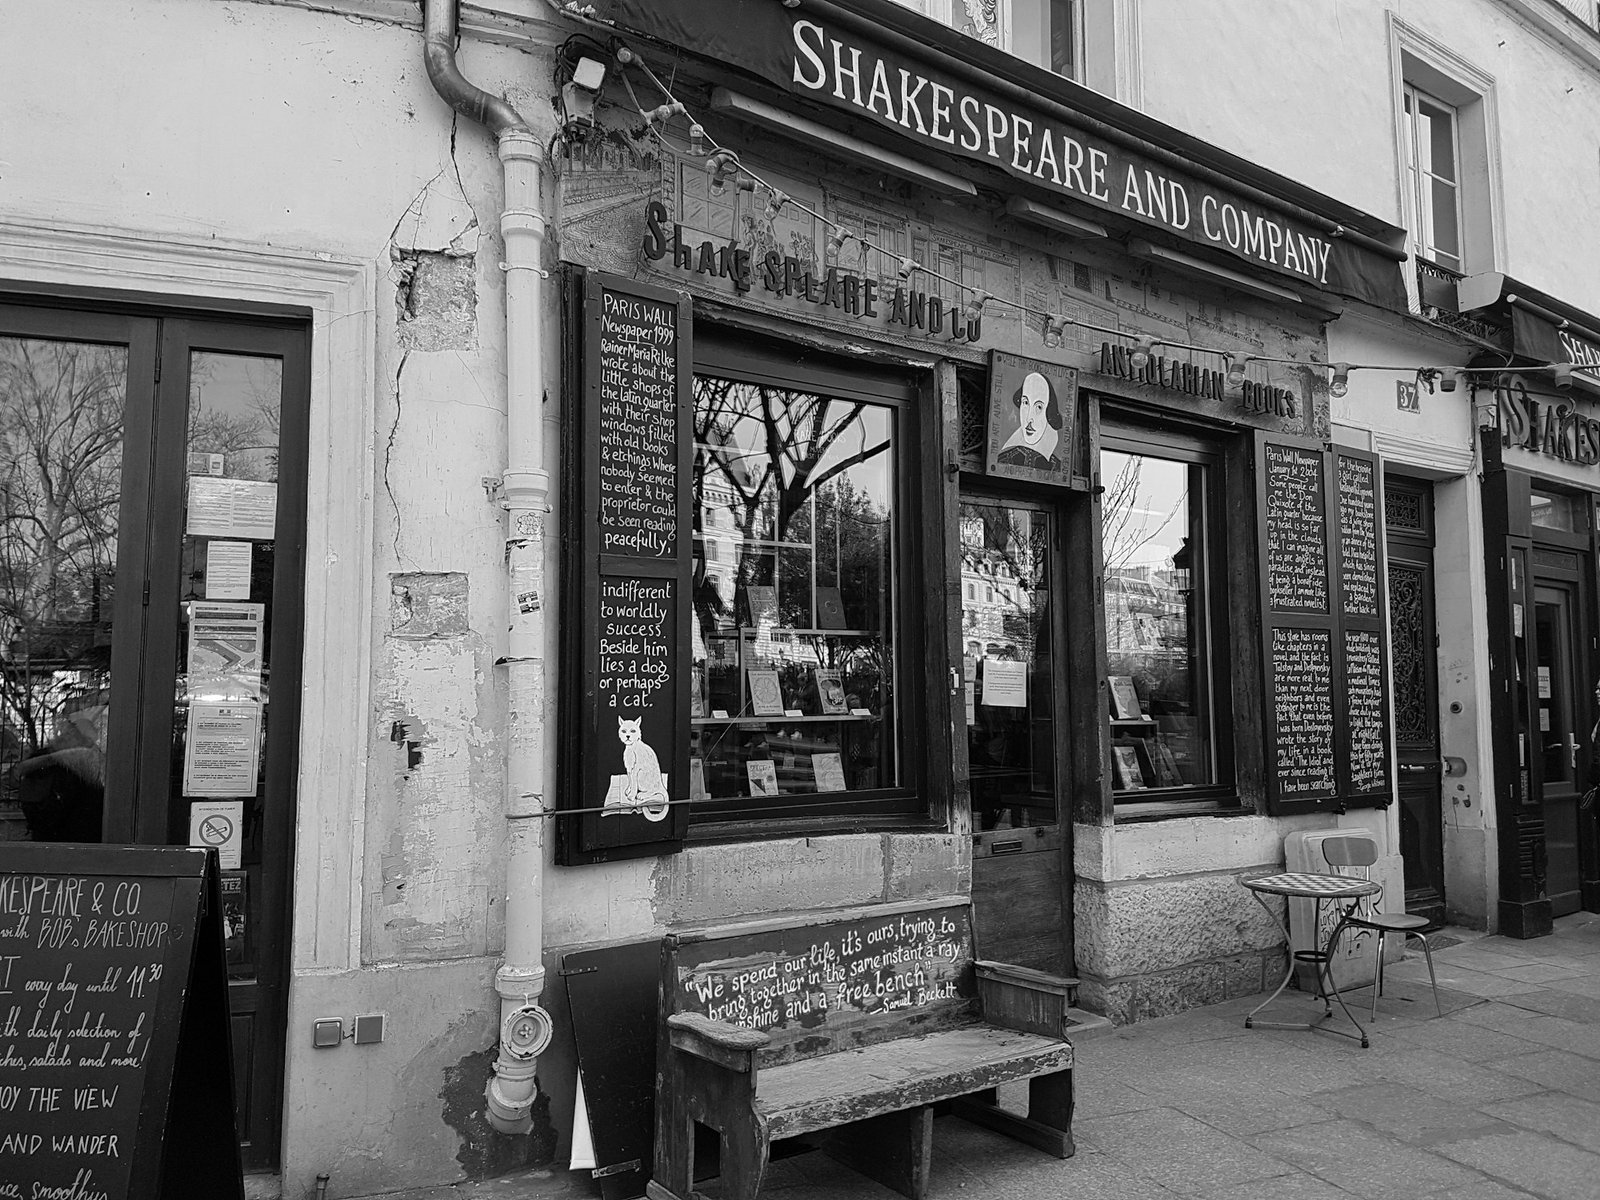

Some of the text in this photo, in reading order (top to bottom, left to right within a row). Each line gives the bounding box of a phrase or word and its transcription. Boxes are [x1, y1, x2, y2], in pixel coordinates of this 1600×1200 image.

[792, 19, 1332, 285] SHAKESPEARE AND COMPANY
[603, 293, 675, 328] PARIS WALL
[892, 287, 943, 334] AND
[602, 314, 674, 346] Newspaper 1999
[601, 338, 675, 368] Rainer Maria Rilke
[601, 356, 675, 384] wrote about the
[601, 385, 676, 413] the latin quarter
[602, 368, 675, 403] little shops of
[1242, 379, 1296, 419] BOOKS
[1399, 384, 1417, 409] 37
[601, 417, 675, 444] windows filled
[602, 401, 675, 433] with their shop
[601, 430, 669, 456] with old books
[1266, 446, 1282, 462] Paris
[601, 446, 676, 474] & etchings. Where
[601, 463, 675, 488] nobody seemed
[1268, 475, 1287, 488] Some
[601, 479, 674, 502] to enter & the
[1267, 494, 1295, 509] Quixote
[1304, 501, 1317, 512] the
[1285, 488, 1297, 499] the
[1299, 490, 1313, 502] Don
[602, 496, 676, 517] proprietor could
[1267, 506, 1283, 518] Latin
[602, 510, 676, 541] be seen reading
[605, 529, 671, 556] peacefully,
[603, 580, 671, 602] indifferent
[601, 600, 667, 625] to worldly
[606, 623, 667, 639] success.
[1272, 628, 1286, 641] This
[1300, 630, 1311, 641] has
[599, 638, 668, 656] Beside him
[601, 656, 669, 683] lies a dog
[599, 673, 661, 694] or perhaps
[609, 690, 653, 707] a cat.
[91, 882, 105, 915] &
[112, 882, 141, 916] CO.
[1, 915, 30, 939] with
[732, 961, 778, 993] spend
[784, 956, 807, 973] our
[809, 941, 840, 971] life,
[842, 930, 862, 956] it's
[867, 923, 899, 944] ours,
[900, 916, 936, 942] trying
[941, 916, 956, 933] to
[57, 963, 79, 1013] day
[86, 967, 122, 993] until
[709, 942, 960, 1021] bring together in the same instant a ray
[917, 981, 957, 1006] Beckett
[786, 990, 811, 1018] and
[819, 992, 827, 1009] a
[835, 982, 871, 1010] free
[27, 1009, 62, 1057] daily
[67, 1011, 122, 1038] selection
[127, 1012, 145, 1054] of
[29, 1042, 72, 1067] salads
[79, 1042, 111, 1067] and
[28, 1087, 63, 1112] THE
[74, 1085, 119, 1111] VIEW
[0, 1132, 119, 1158] AND WANDER
